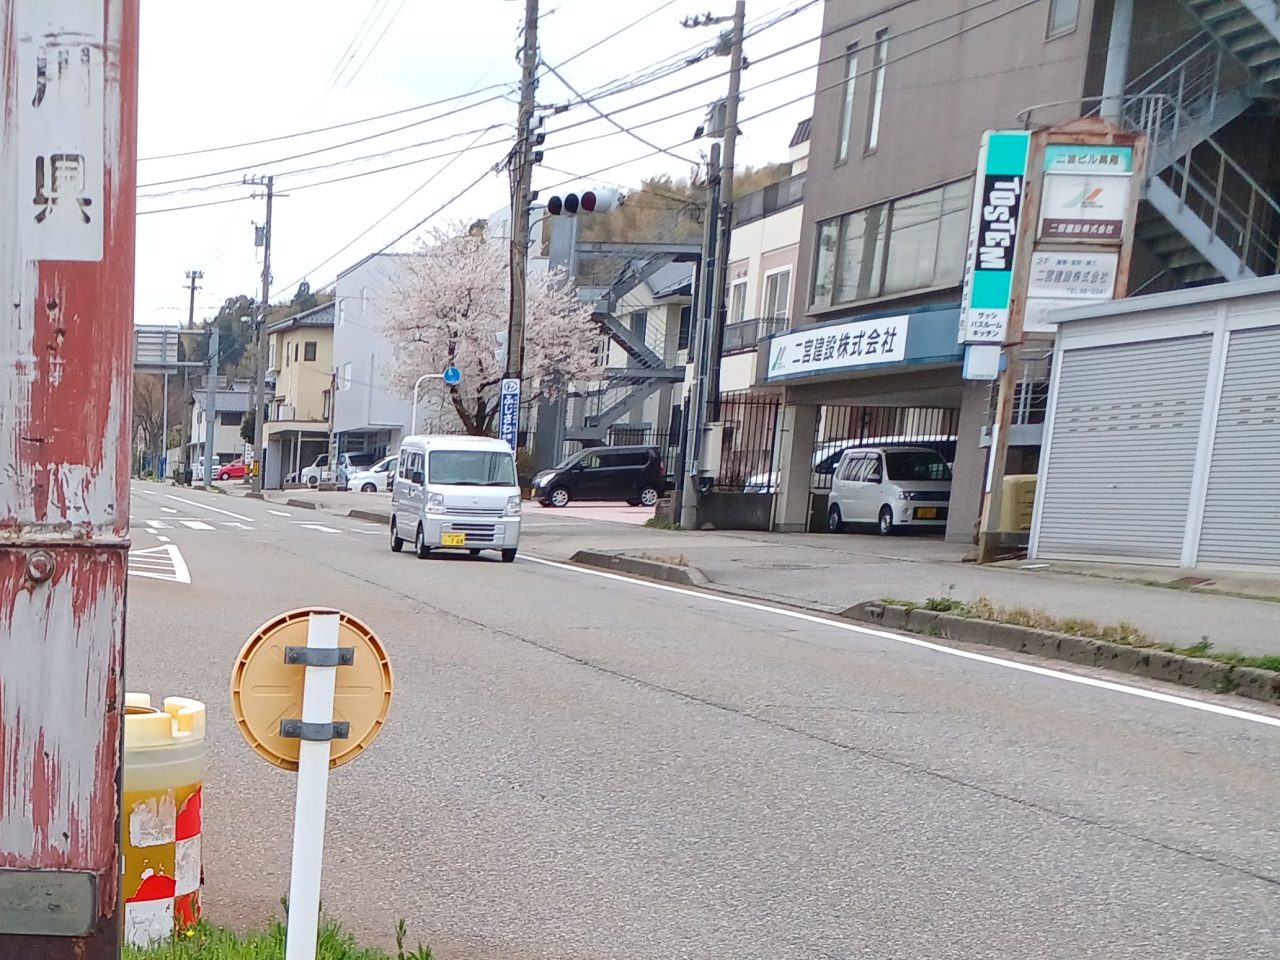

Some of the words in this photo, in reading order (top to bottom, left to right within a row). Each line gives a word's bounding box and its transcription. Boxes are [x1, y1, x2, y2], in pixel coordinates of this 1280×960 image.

[979, 176, 1020, 270] TOSTEM
[970, 321, 1003, 329] バスルーム
[973, 330, 1000, 338] キッチン
[792, 326, 898, 364] 二宮建設株式会社
